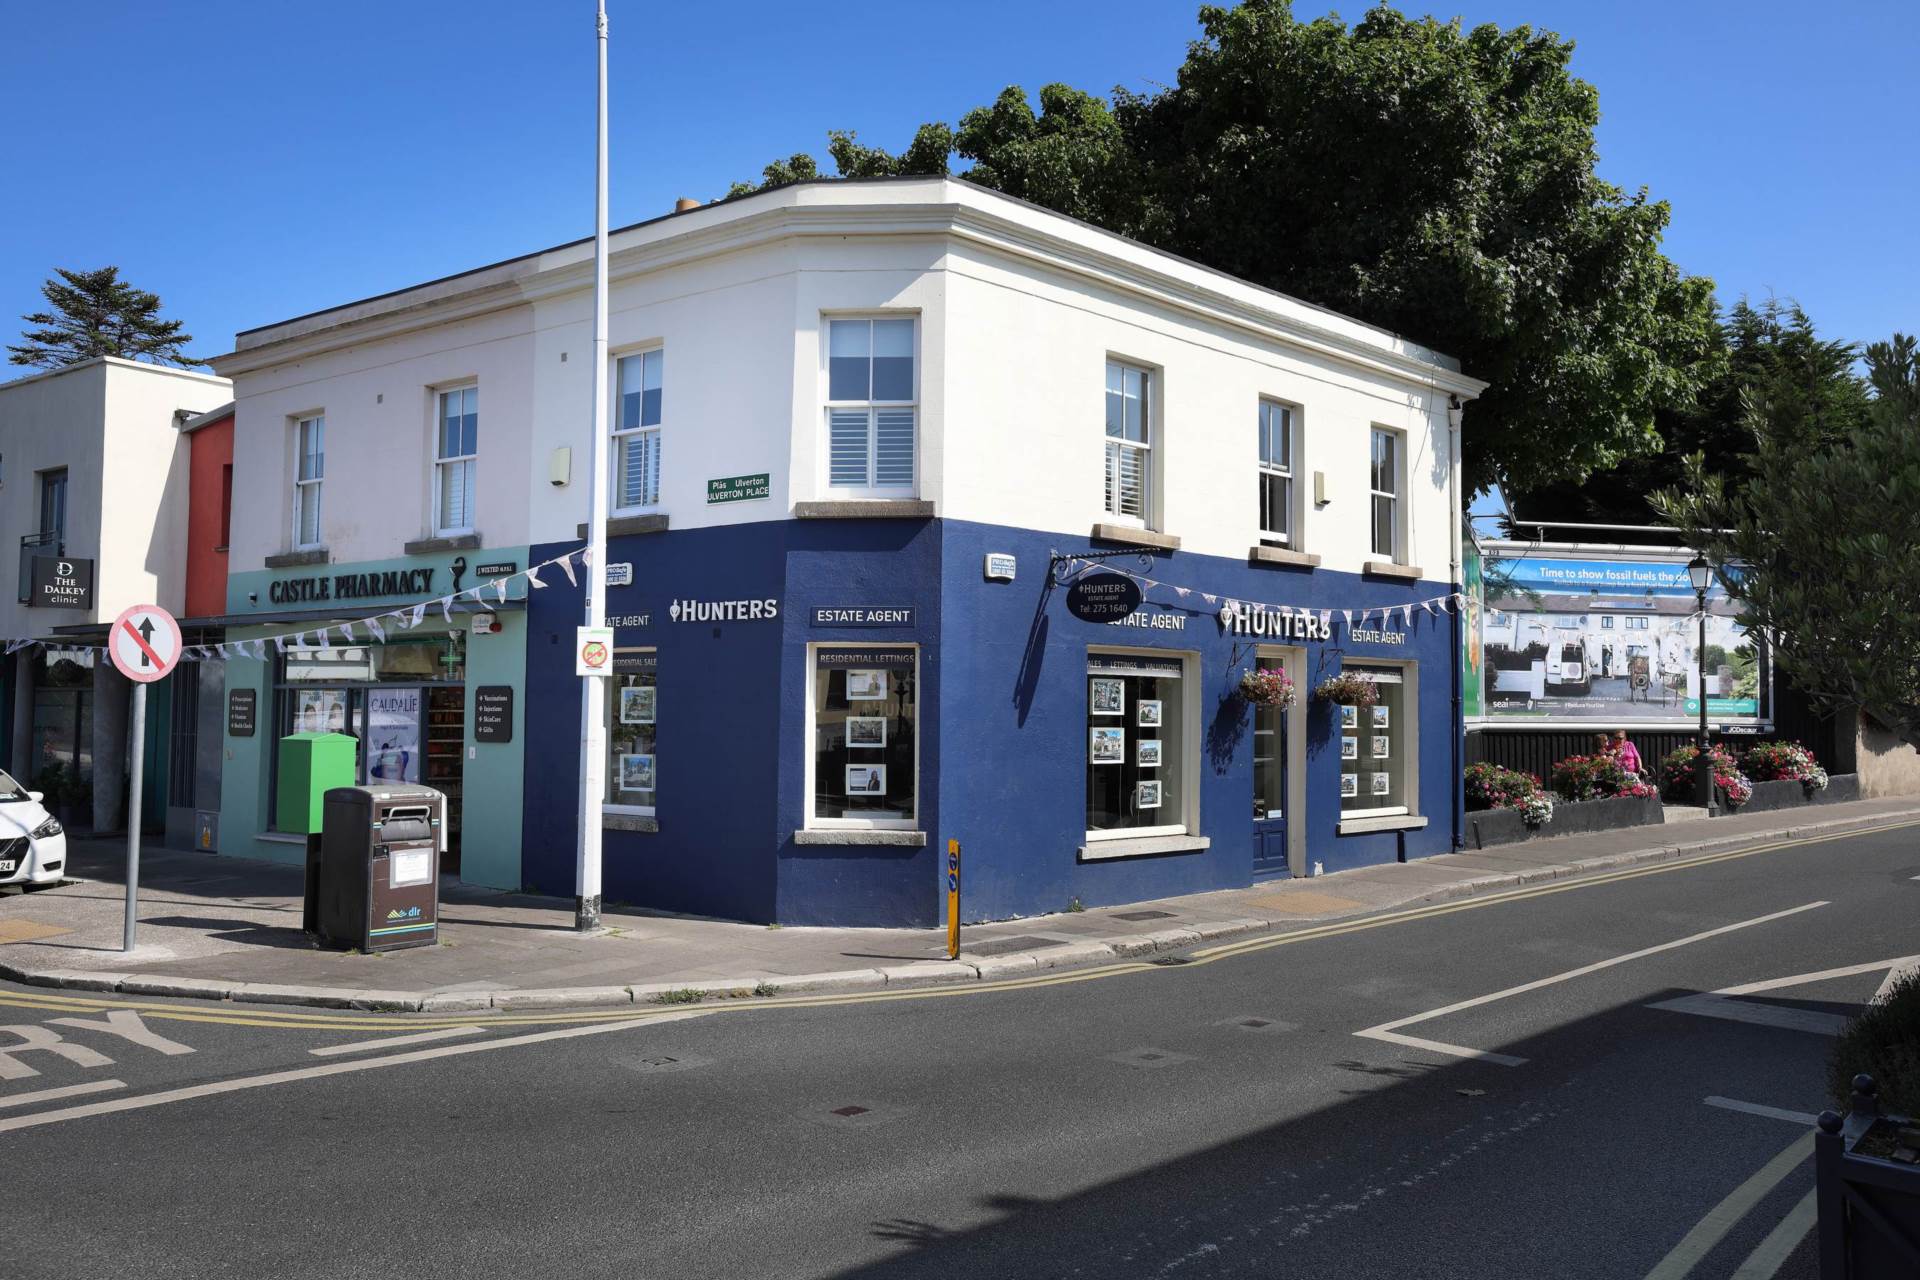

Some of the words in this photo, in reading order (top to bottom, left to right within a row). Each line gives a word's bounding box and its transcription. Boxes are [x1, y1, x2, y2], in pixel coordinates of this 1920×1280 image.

[735, 477, 764, 488] Ulverton
[708, 490, 743, 500] ULVERTON
[746, 486, 769, 496] PLACE
[1539, 567, 1564, 579] Time
[1565, 568, 1575, 579] to
[1577, 568, 1605, 580] show
[1606, 569, 1631, 581] fossil
[1632, 570, 1657, 582] fuels
[1658, 572, 1674, 582] the
[54, 576, 76, 586] THE
[269, 577, 330, 604] CASTLE
[334, 568, 434, 598] PHARMACY
[44, 585, 86, 595] DALKEY
[1083, 584, 1127, 593] HUNTERS
[51, 595, 78, 604] clinic
[681, 599, 778, 622] HUNTERS
[1093, 604, 1107, 613] 275
[1110, 604, 1128, 613] 1640
[622, 615, 649, 626] AGENT
[817, 610, 864, 622] ESTATE
[866, 610, 910, 622] AGENT
[1107, 612, 1148, 628] TATE
[1150, 614, 1186, 630] AGENT
[1234, 602, 1331, 640] HUNTERS
[1352, 629, 1380, 643] ESTATE
[1381, 632, 1405, 645] AGENT
[820, 654, 872, 663] RESIDENTIAL
[875, 654, 914, 663] LETTINGS
[1088, 660, 1101, 668] ALES
[1110, 660, 1137, 670] LETTINGS
[1493, 698, 1509, 708] seai
[1728, 726, 1757, 734] JCDecaux
[408, 907, 421, 917] dlr
